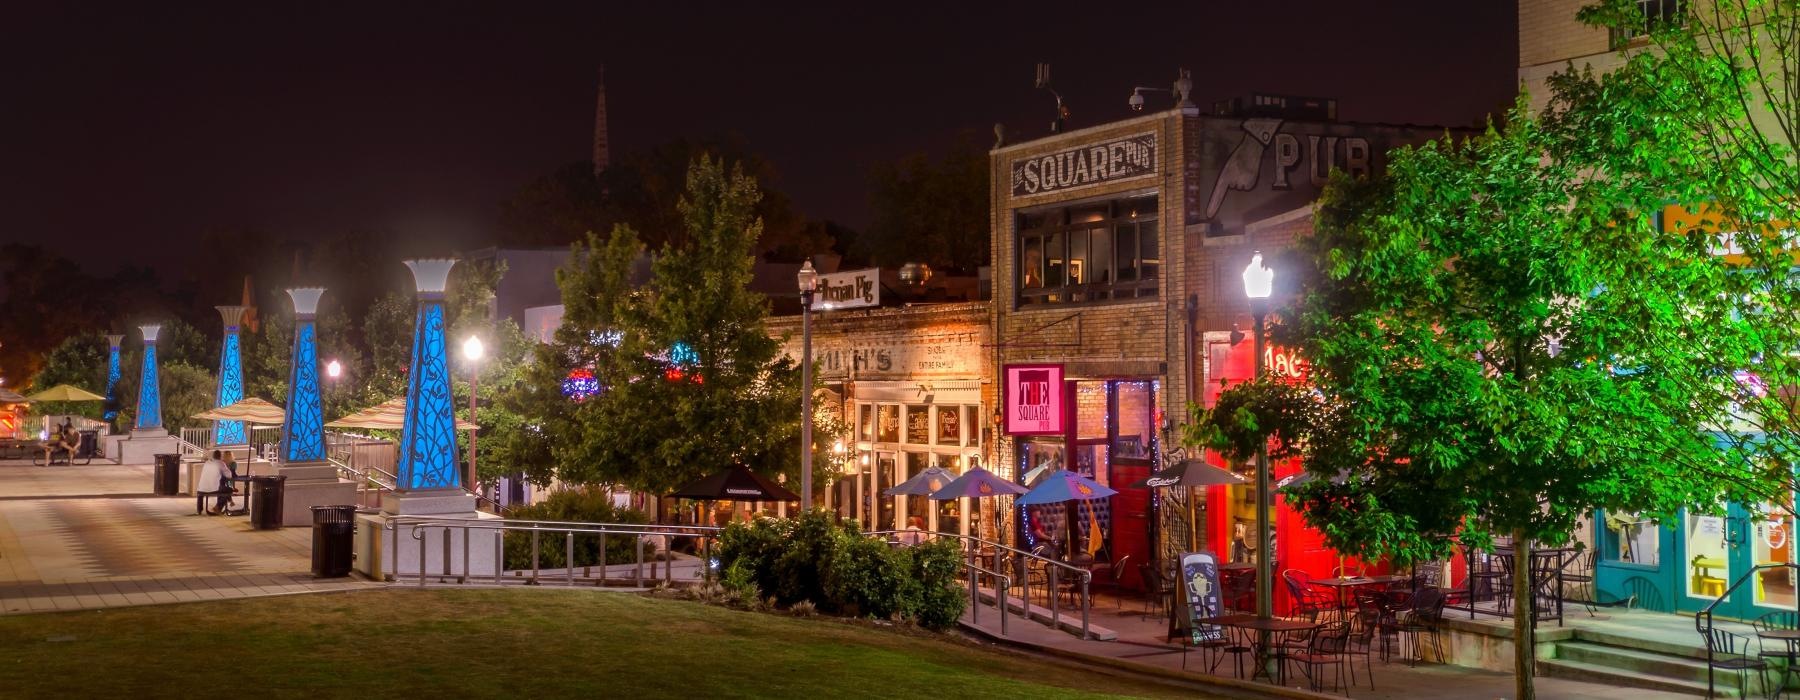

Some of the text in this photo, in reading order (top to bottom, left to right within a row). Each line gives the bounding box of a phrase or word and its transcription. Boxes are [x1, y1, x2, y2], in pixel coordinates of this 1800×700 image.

[1024, 141, 1126, 193] SQUARE
[1126, 141, 1149, 168] PUB
[1272, 133, 1370, 188] PUB
[856, 275, 873, 303] Pig
[935, 361, 954, 369] FAMLY
[1020, 381, 1049, 405] THE
[1018, 405, 1050, 421] SQUARE
[1039, 420, 1050, 430] PUB
